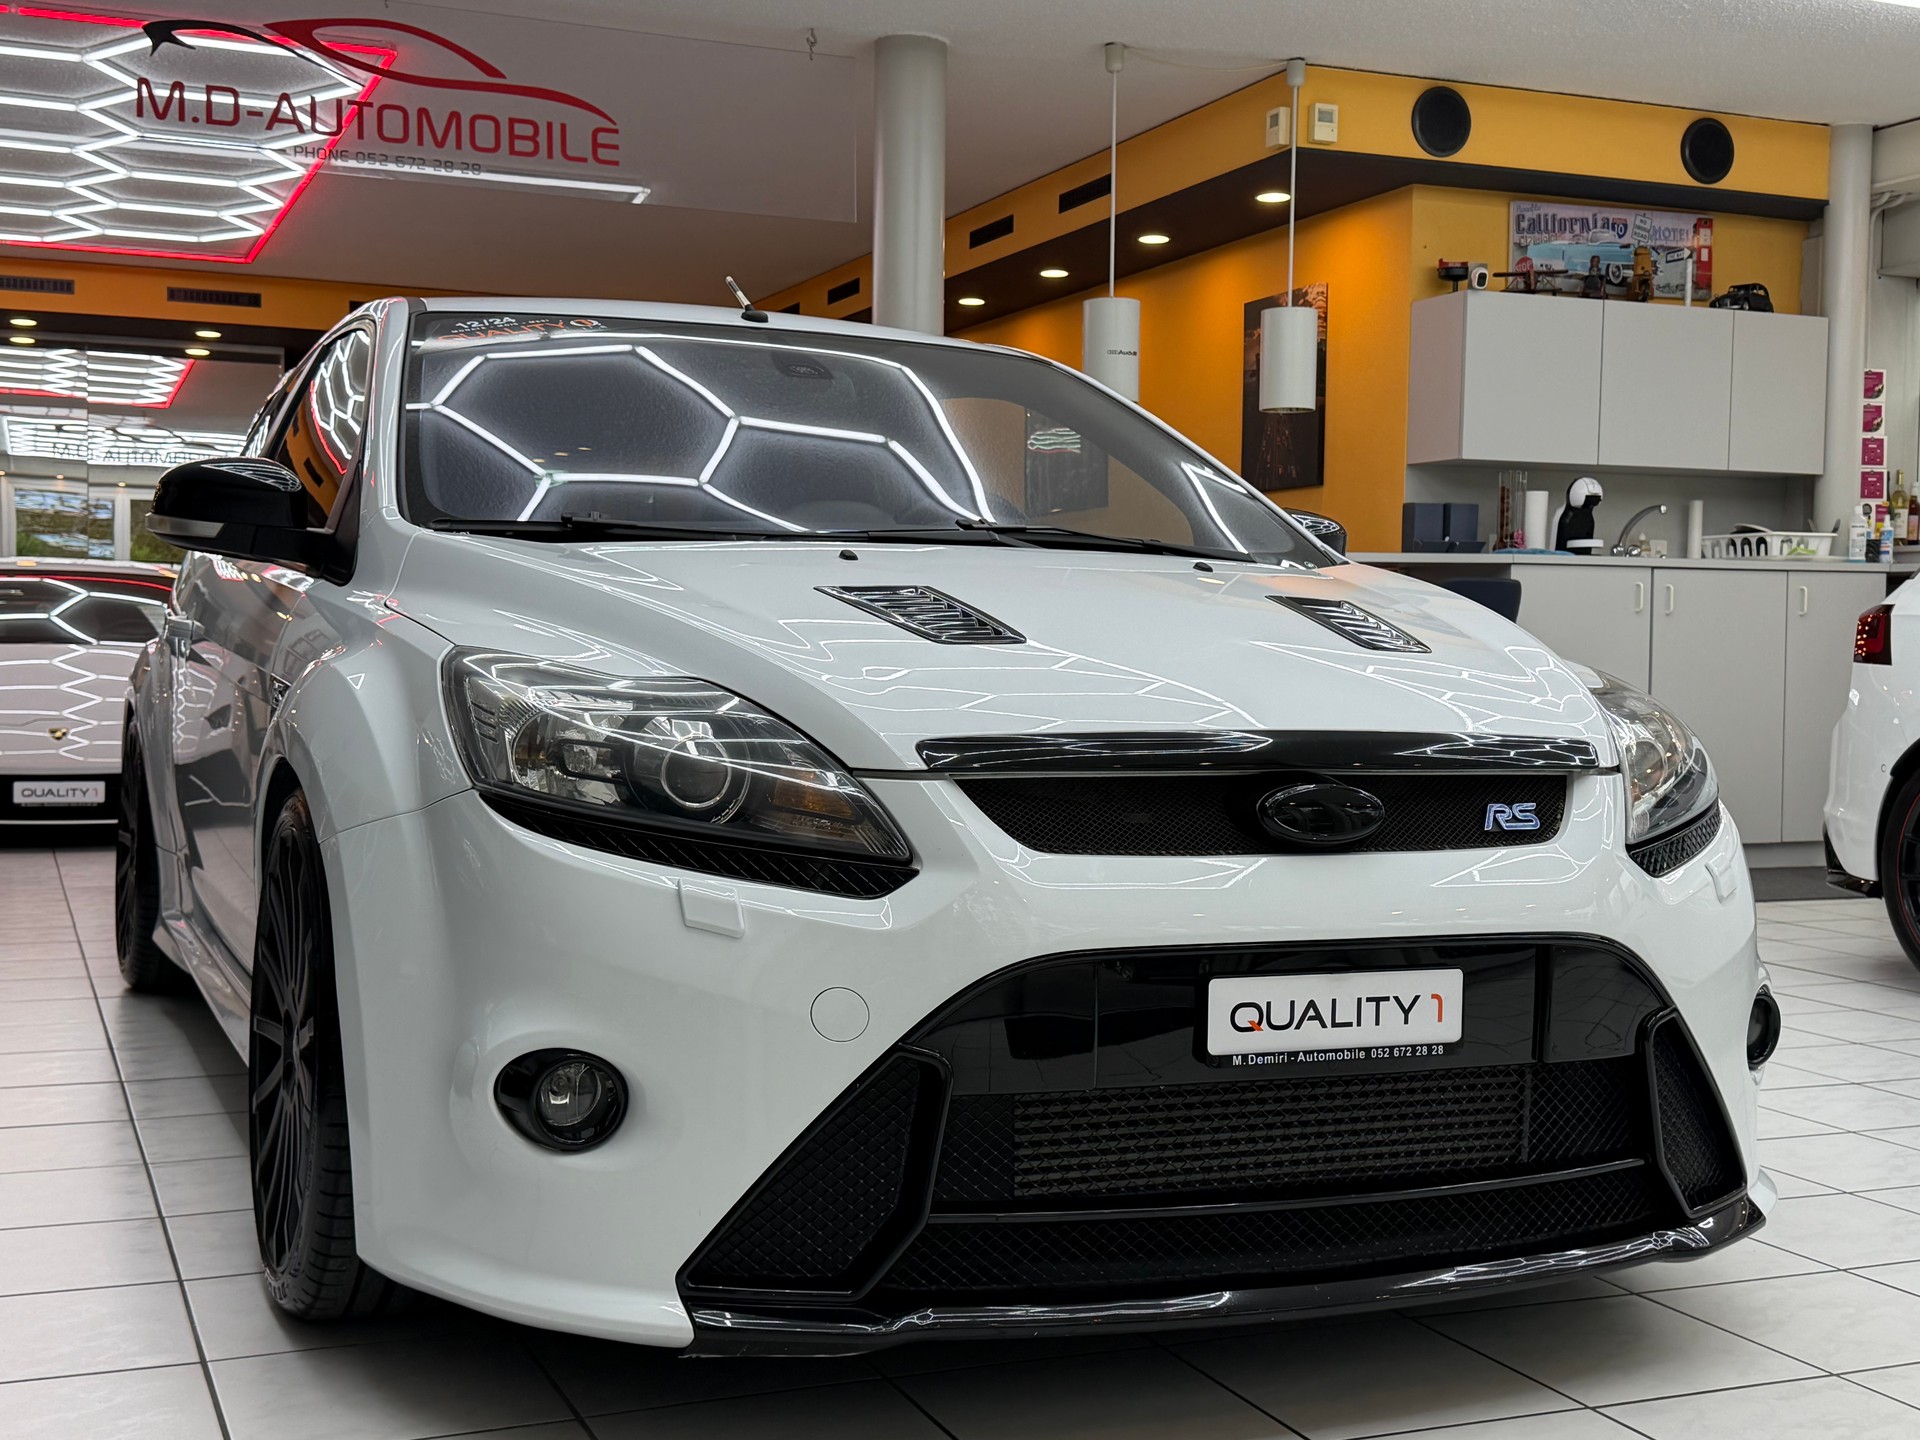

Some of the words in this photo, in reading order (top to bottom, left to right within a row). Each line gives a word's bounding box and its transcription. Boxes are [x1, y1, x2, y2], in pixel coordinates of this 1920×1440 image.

[135, 77, 620, 167] M.D-AUTOMOBILE
[293, 145, 350, 163] PHONE
[355, 151, 389, 167] 052
[394, 155, 426, 171] 672
[433, 159, 454, 173] 28
[460, 161, 482, 176] 28
[1515, 212, 1610, 235] California
[1614, 224, 1625, 236] 10
[1515, 259, 1533, 273] STOP
[455, 316, 517, 329] 12/24
[1484, 802, 1541, 831] RS
[1248, 1052, 1288, 1065] Demiri
[1296, 1048, 1366, 1064] Automobile
[1370, 1047, 1390, 1059] 052
[1393, 1046, 1412, 1057] 672
[1415, 1045, 1428, 1056] 28
[1431, 1045, 1444, 1055] 28
